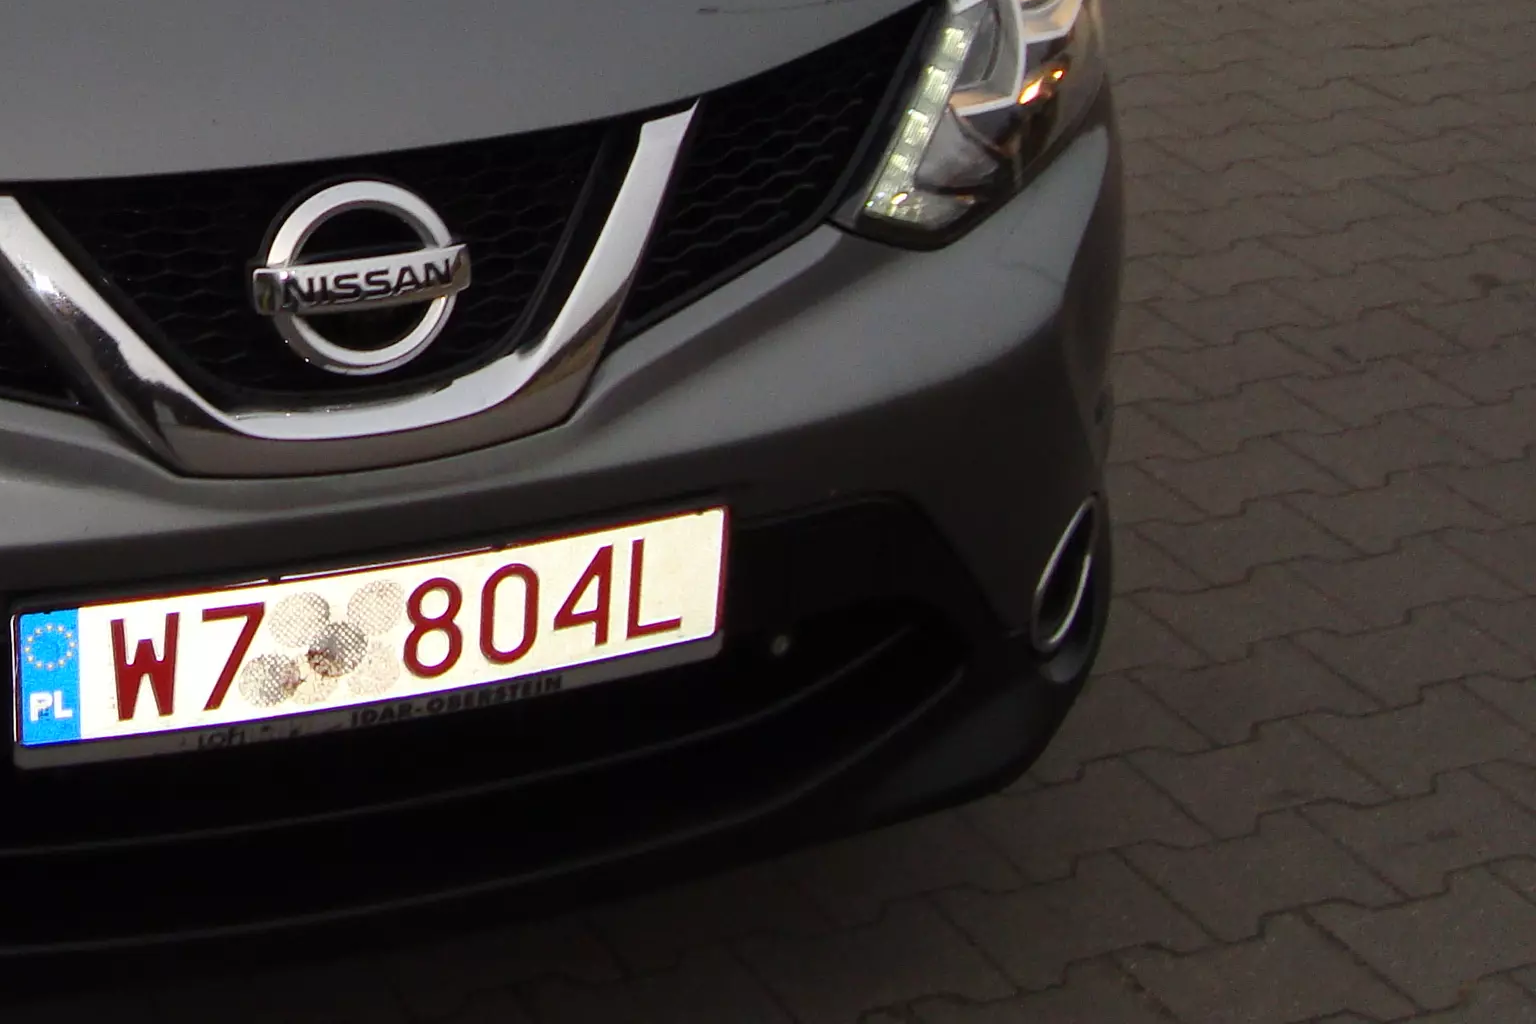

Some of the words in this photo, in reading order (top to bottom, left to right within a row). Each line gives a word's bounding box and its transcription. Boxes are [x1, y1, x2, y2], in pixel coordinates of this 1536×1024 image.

[282, 257, 452, 307] NISSAN
[109, 601, 267, 721] W7
[401, 538, 682, 679] 804L
[30, 690, 73, 722] PL
